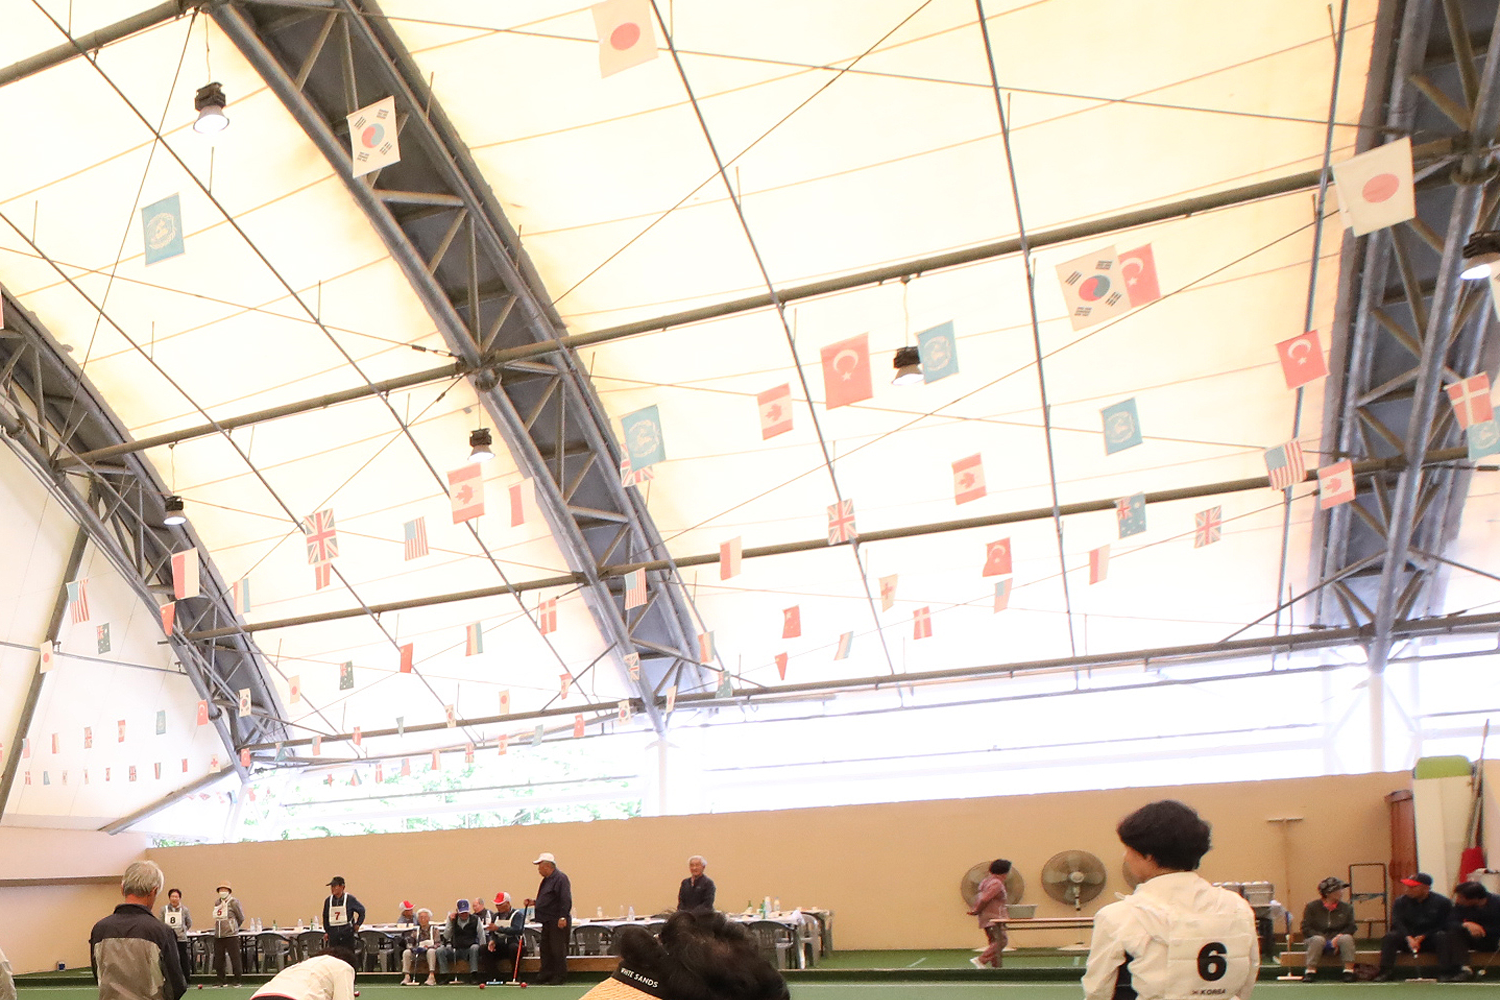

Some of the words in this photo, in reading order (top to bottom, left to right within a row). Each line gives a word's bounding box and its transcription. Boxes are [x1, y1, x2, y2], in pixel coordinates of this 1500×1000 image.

[169, 916, 176, 924] 8
[334, 911, 341, 921] 7
[1197, 941, 1228, 982] 6
[634, 973, 659, 988] SANDS
